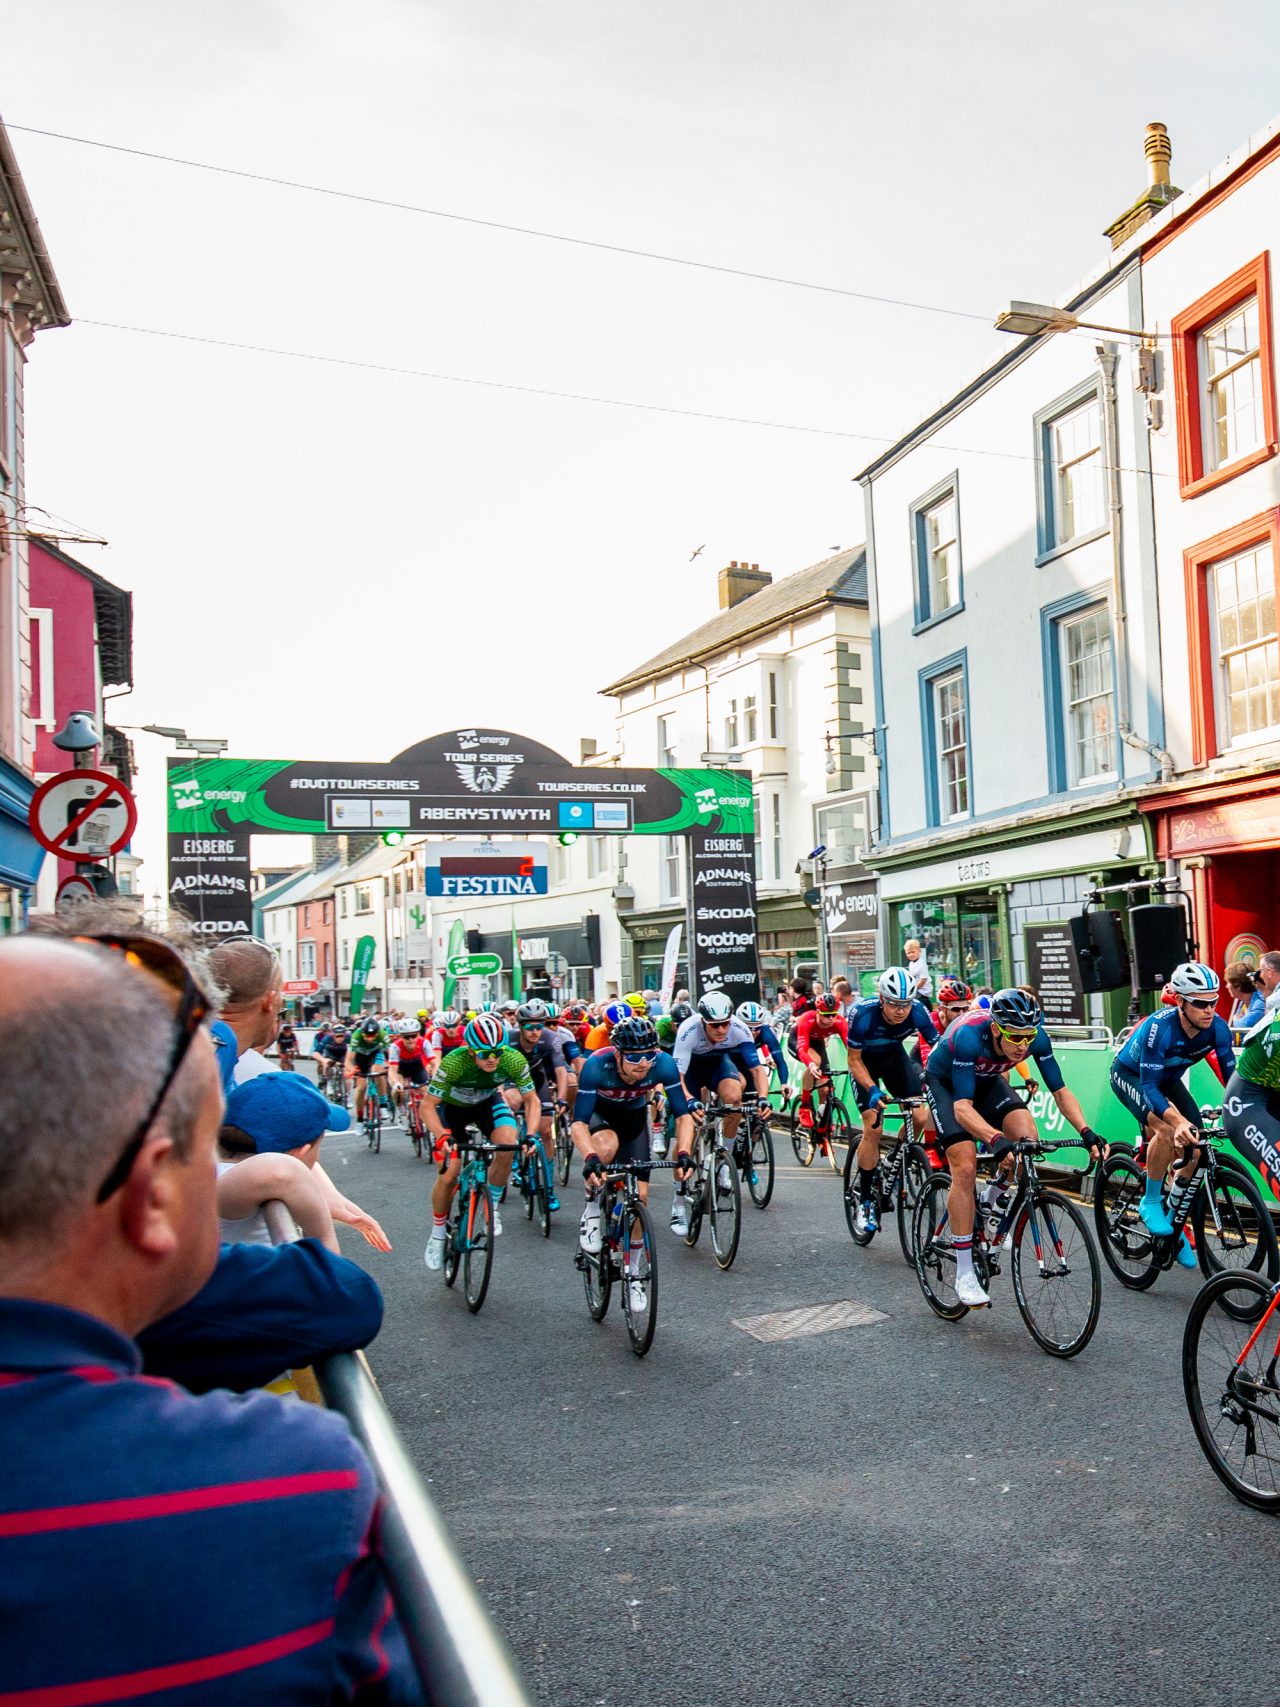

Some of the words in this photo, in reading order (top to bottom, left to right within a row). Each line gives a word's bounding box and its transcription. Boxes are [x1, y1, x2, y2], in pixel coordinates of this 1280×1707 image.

[479, 736, 510, 746] energy
[443, 752, 478, 763] TOUR
[479, 753, 524, 764] SERIES
[289, 778, 420, 791] #OVOTOURSERIES
[536, 782, 648, 793] TOURSERIES.CO.UK
[203, 788, 248, 803] energy
[718, 795, 751, 808] energy
[419, 807, 551, 821] ABERYSTWYTH
[183, 839, 235, 854] EISBERG
[704, 838, 743, 852] EISBERG
[519, 856, 534, 876] 2
[441, 876, 537, 895] FESTINA
[845, 893, 878, 917] energy
[696, 907, 756, 920] ŠKODA
[696, 931, 756, 947] brother
[723, 973, 756, 984] energy
[1147, 1022, 1159, 1048] MAXXIS
[1113, 1071, 1141, 1106] CANYON
[932, 1108, 944, 1135] Condor
[882, 1151, 904, 1196] CANYON
[1174, 1177, 1201, 1223] CANYON
